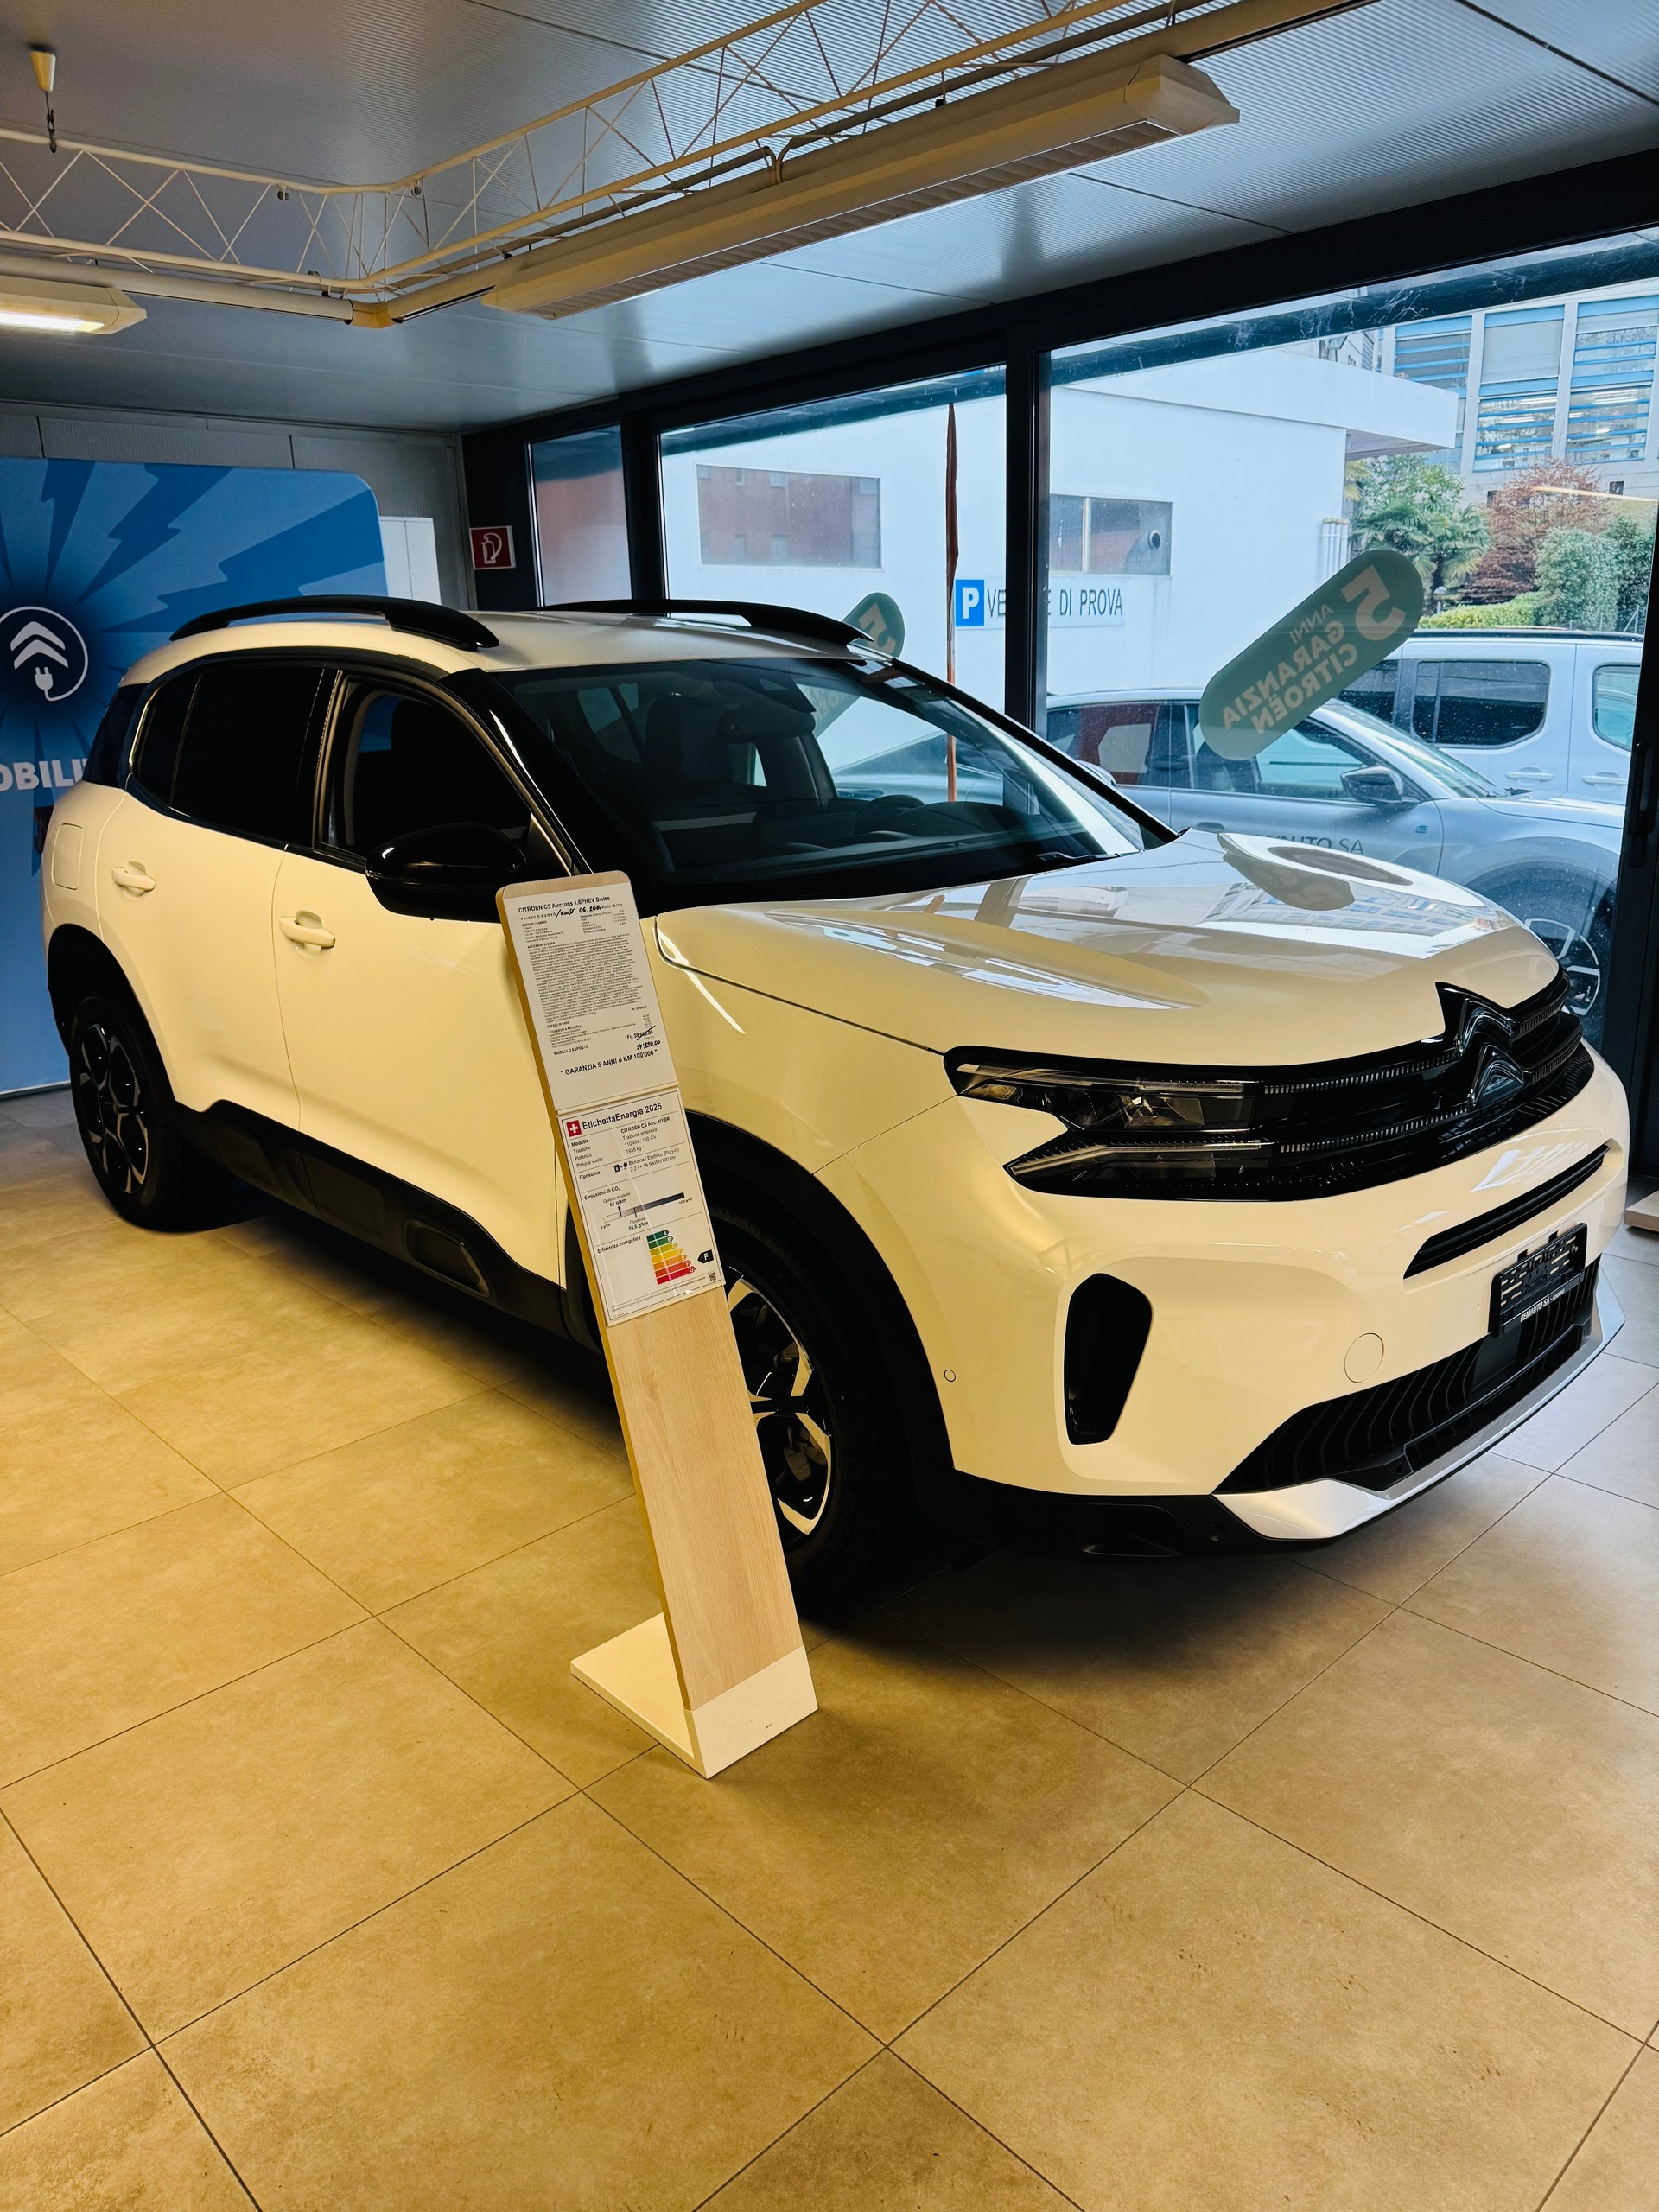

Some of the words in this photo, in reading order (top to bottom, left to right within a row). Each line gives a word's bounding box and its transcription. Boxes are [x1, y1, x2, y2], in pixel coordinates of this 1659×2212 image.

[962, 587, 980, 620] P
[1059, 589, 1072, 617] DI
[1080, 588, 1123, 617] PROVA
[1339, 838, 1363, 855] SA
[518, 905, 543, 913] CITROEN
[565, 1064, 596, 1075] GARANZIA
[634, 1050, 654, 1059] 100'000
[582, 1108, 644, 1130] EtichettaEnergia
[645, 1103, 663, 1114] 2025
[572, 1139, 589, 1147] Modello
[621, 1124, 640, 1134] CITROEN
[574, 1146, 591, 1154] Trazione
[623, 1132, 639, 1141] Trazione
[575, 1153, 592, 1161] Potenza
[580, 1171, 601, 1180] Consumo
[585, 1190, 607, 1200] Emissioni
